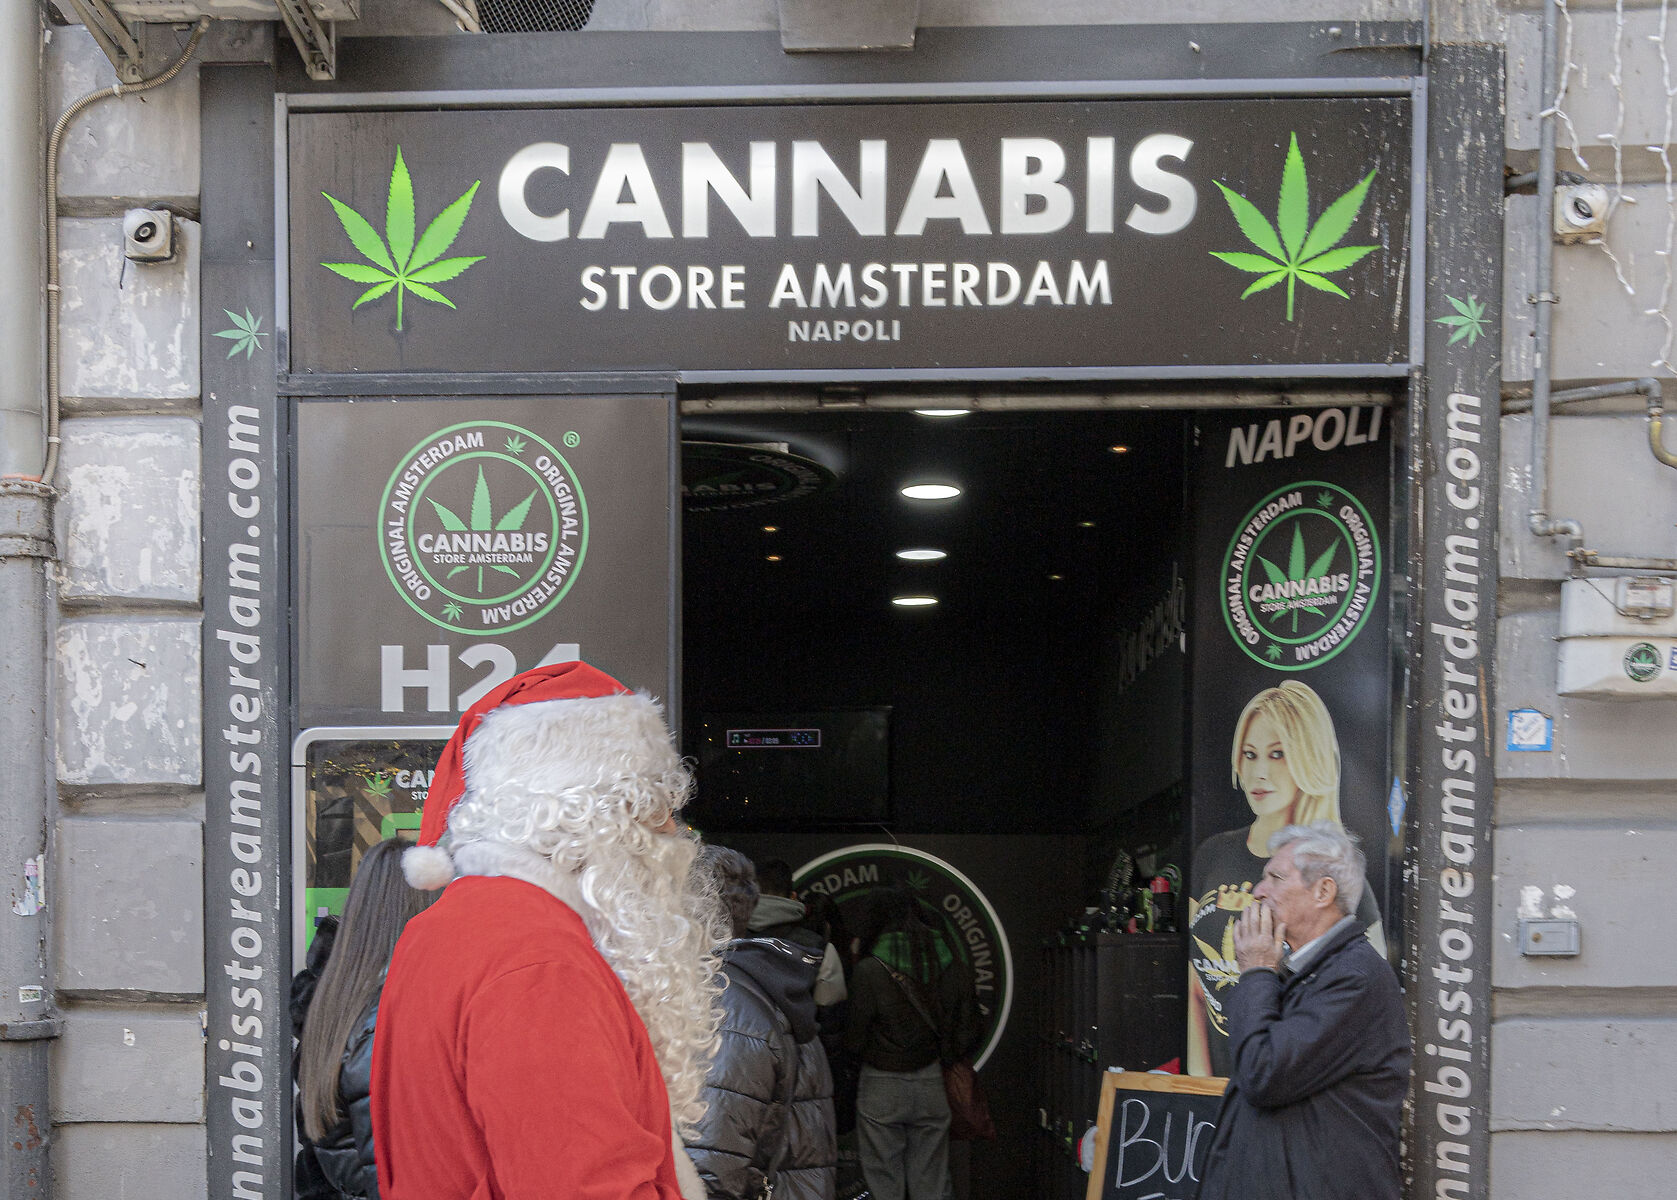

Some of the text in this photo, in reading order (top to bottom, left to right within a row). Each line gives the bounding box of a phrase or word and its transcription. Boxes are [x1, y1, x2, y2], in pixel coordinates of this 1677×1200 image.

[498, 133, 1198, 242] CANNABIS
[579, 259, 1113, 310] STORE AMSTERDAM
[787, 319, 901, 342] NAPOLI
[1225, 406, 1383, 468] NAPOLI
[388, 431, 485, 601] ORIGINAL AMSTERDAM
[417, 532, 549, 554] CANNABIS
[481, 455, 579, 625] ORIGINAL AMSTERDAM
[433, 553, 533, 564] STORE AMSTERDAM
[1228, 491, 1303, 645] ORIGINAL AMSTERDAM
[1249, 573, 1350, 603] CANNABIS
[1294, 505, 1374, 661] ORIGINAL AMSTERDAM
[942, 893, 995, 995] ORIGINAL
